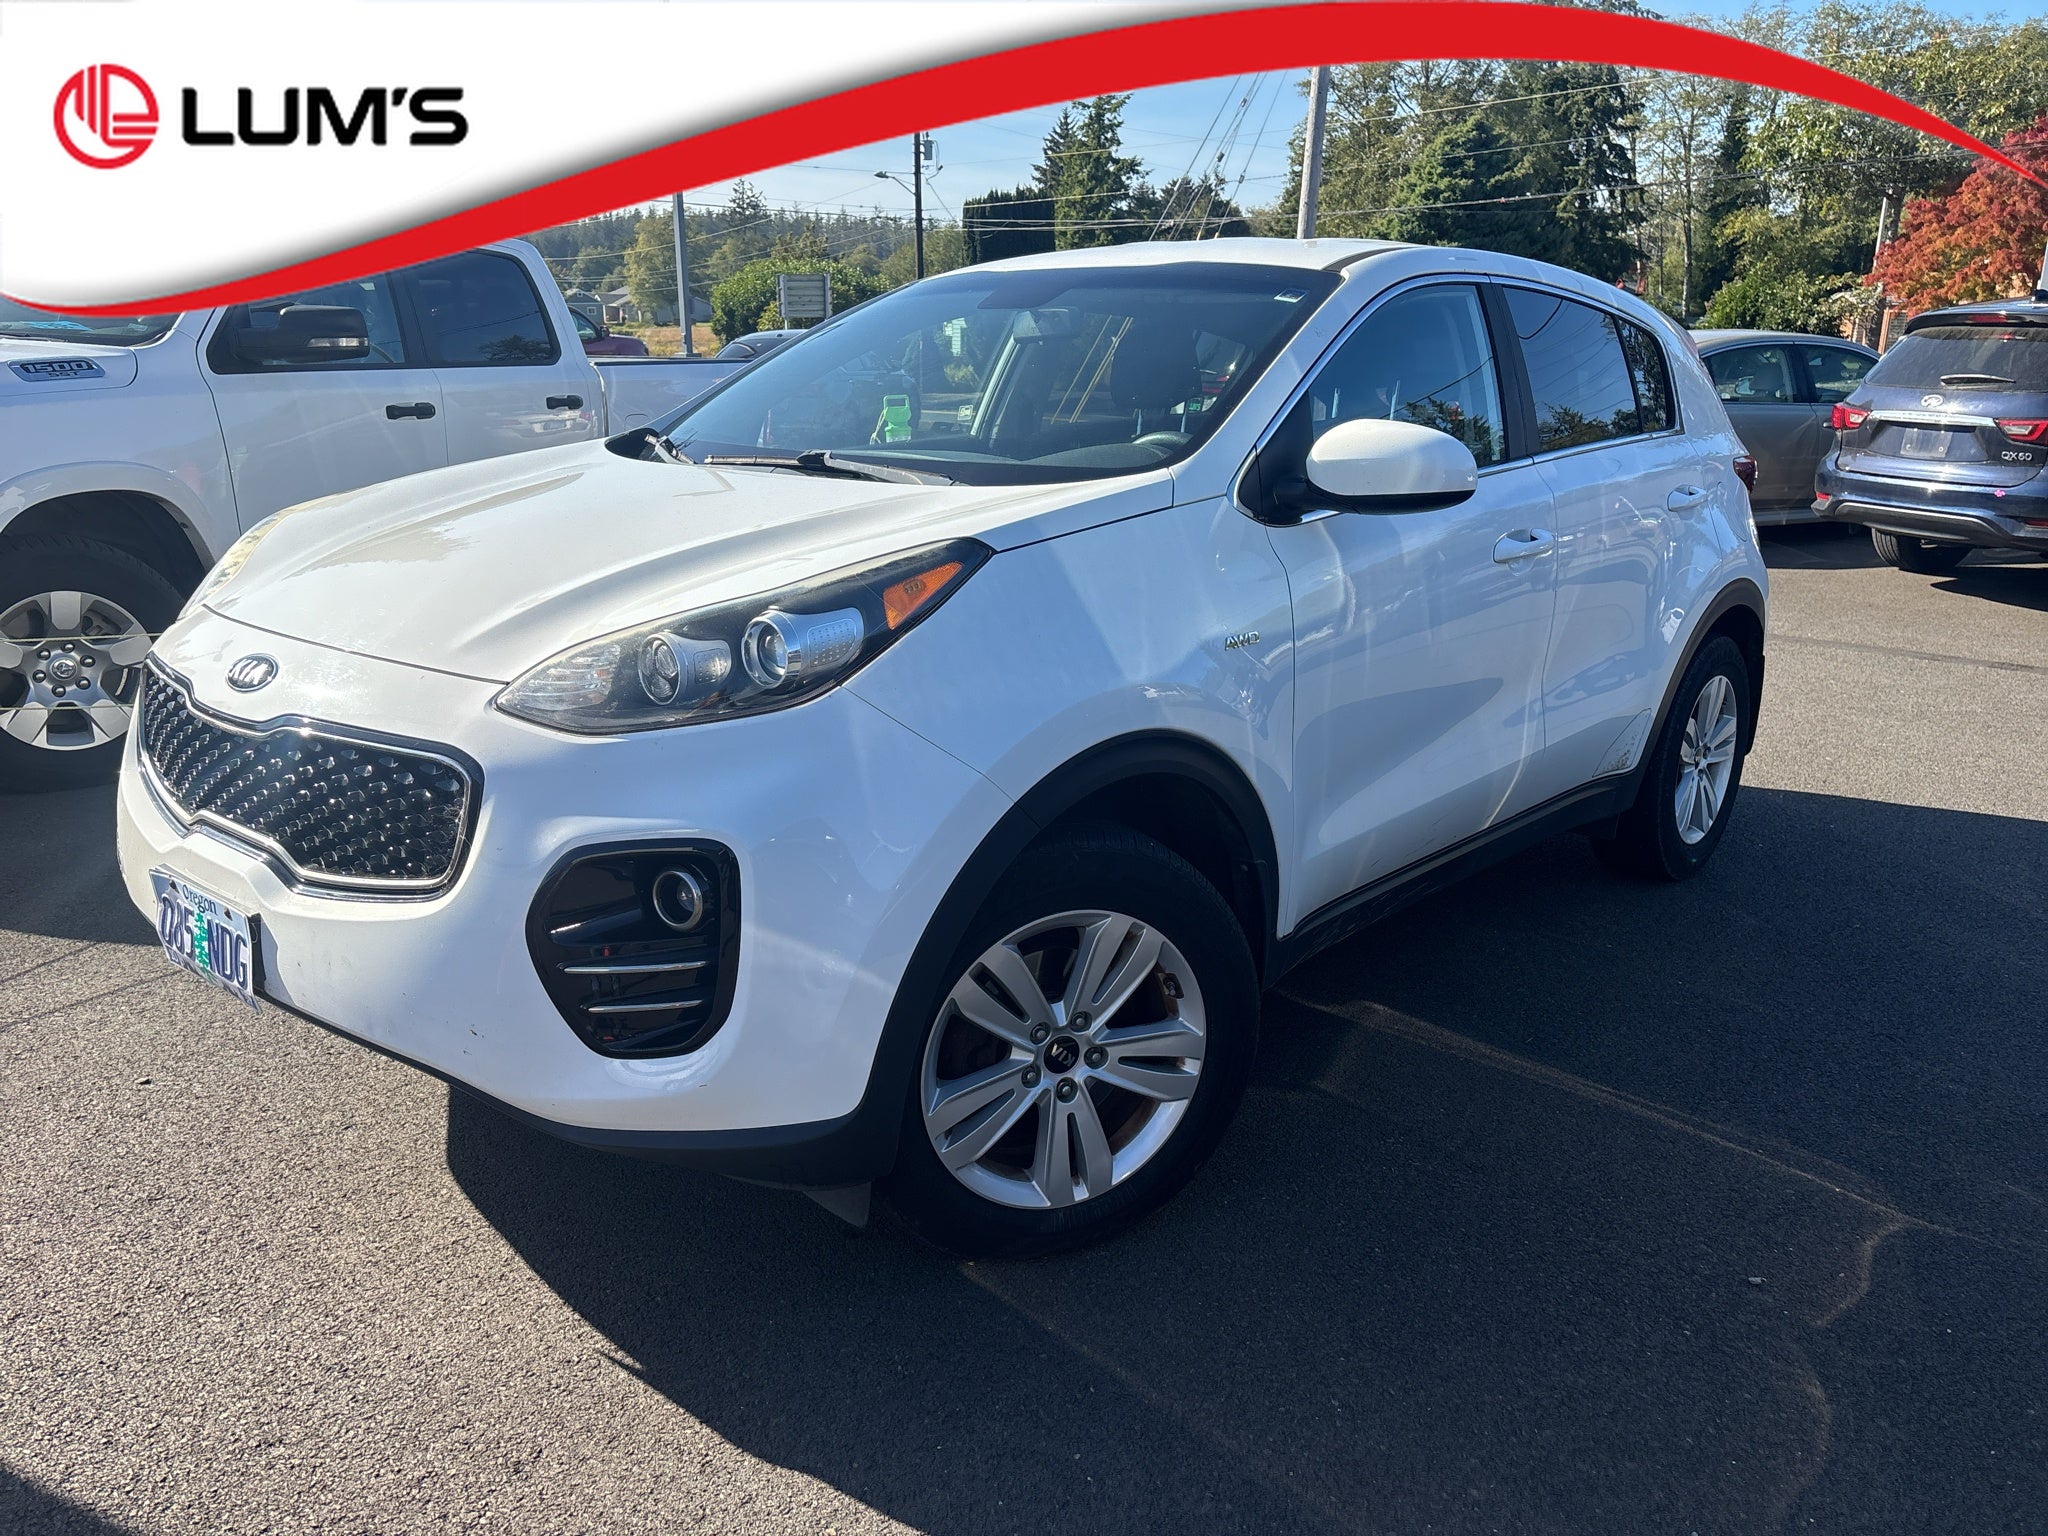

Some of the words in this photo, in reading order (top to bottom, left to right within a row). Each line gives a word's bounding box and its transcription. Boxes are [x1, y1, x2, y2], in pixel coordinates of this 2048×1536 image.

[23, 361, 88, 373] 1500
[2001, 451, 2033, 461] QX60
[1225, 631, 1260, 651] AWD
[227, 658, 269, 685] KIA
[182, 884, 218, 916] Oregon
[161, 895, 195, 959] 085
[206, 916, 249, 991] NDG
[1051, 1042, 1075, 1067] KIA
